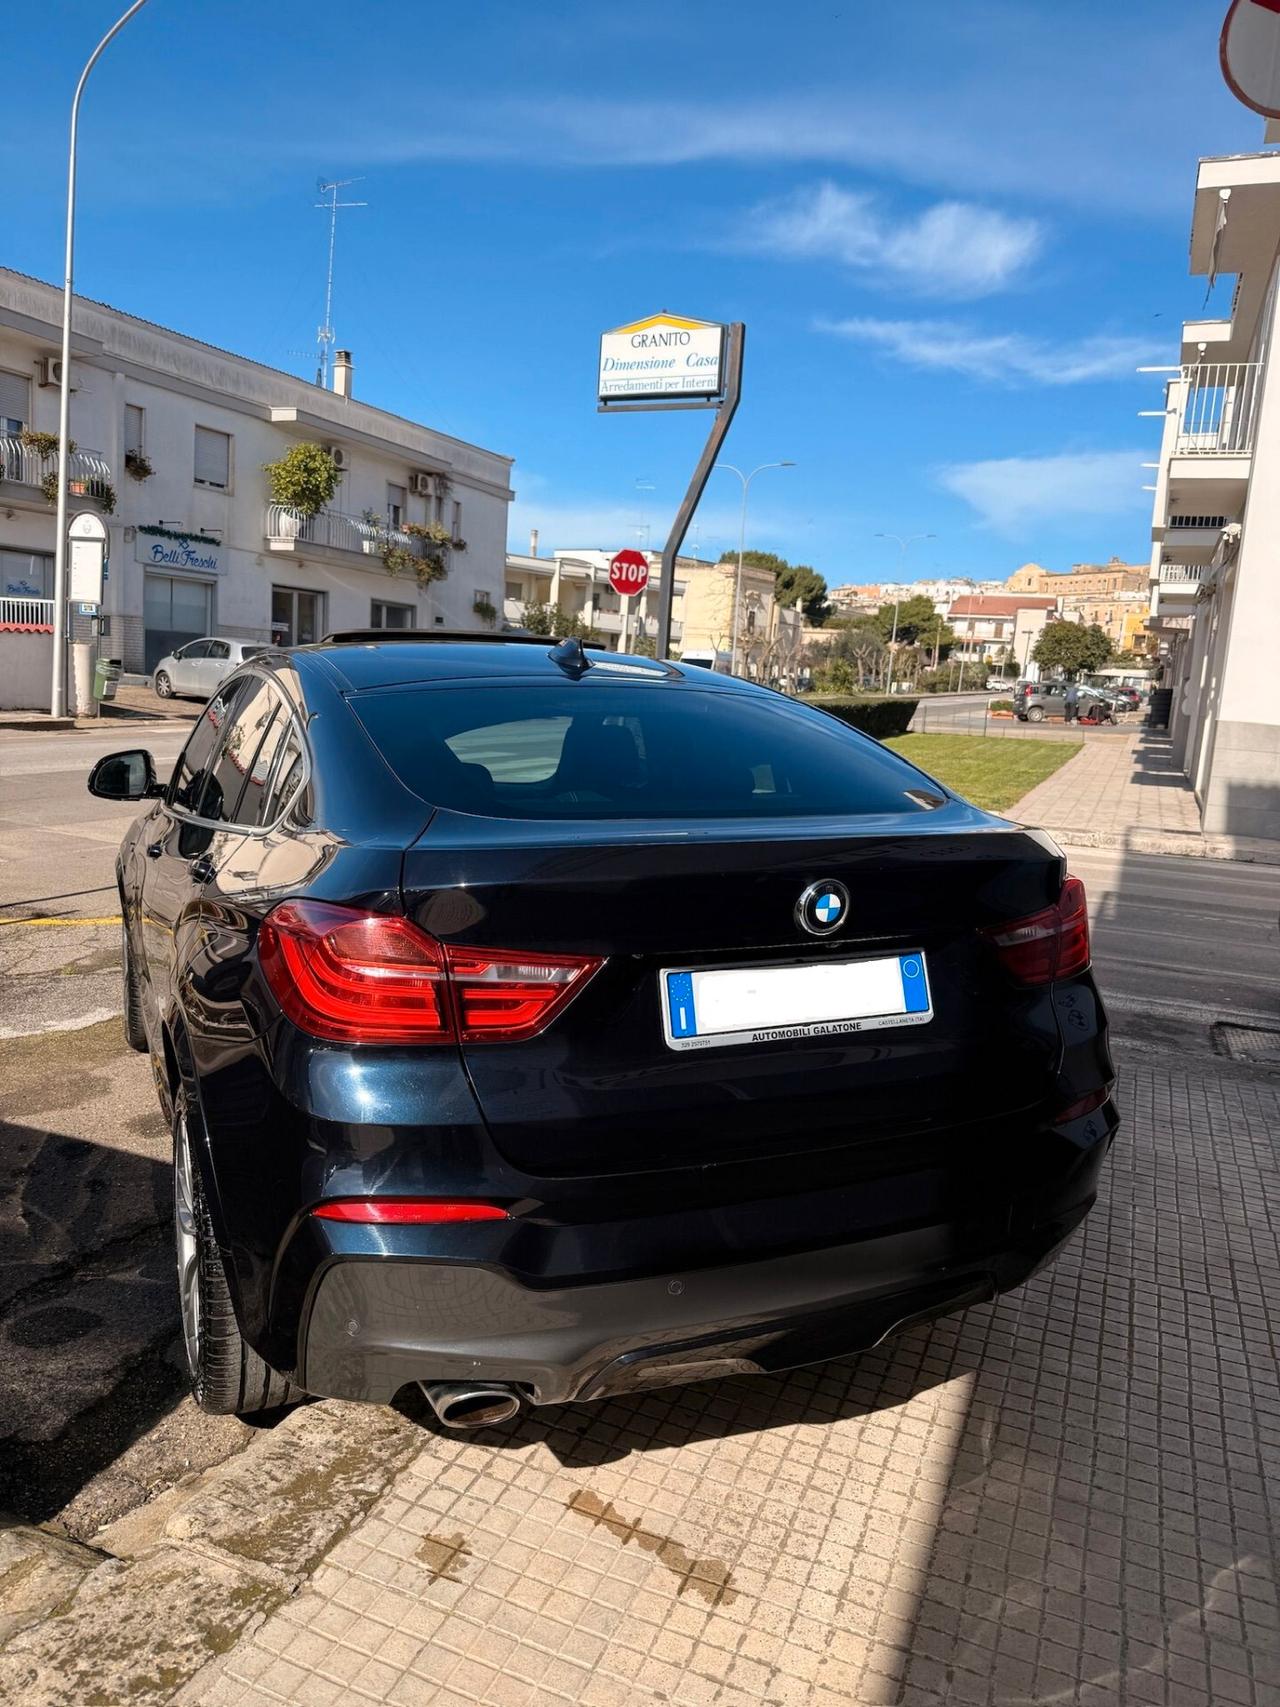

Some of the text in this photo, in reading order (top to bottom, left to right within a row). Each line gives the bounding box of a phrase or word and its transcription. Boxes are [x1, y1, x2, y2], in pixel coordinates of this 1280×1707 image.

[631, 332, 691, 348] GRANITO
[602, 352, 719, 371] Dimensione Casa
[601, 376, 717, 392] Arredamenti per Interni
[150, 544, 218, 569] Belli Freschi
[611, 561, 647, 583] STOP
[752, 1022, 862, 1042] AUTOMOBILI GALATONE
